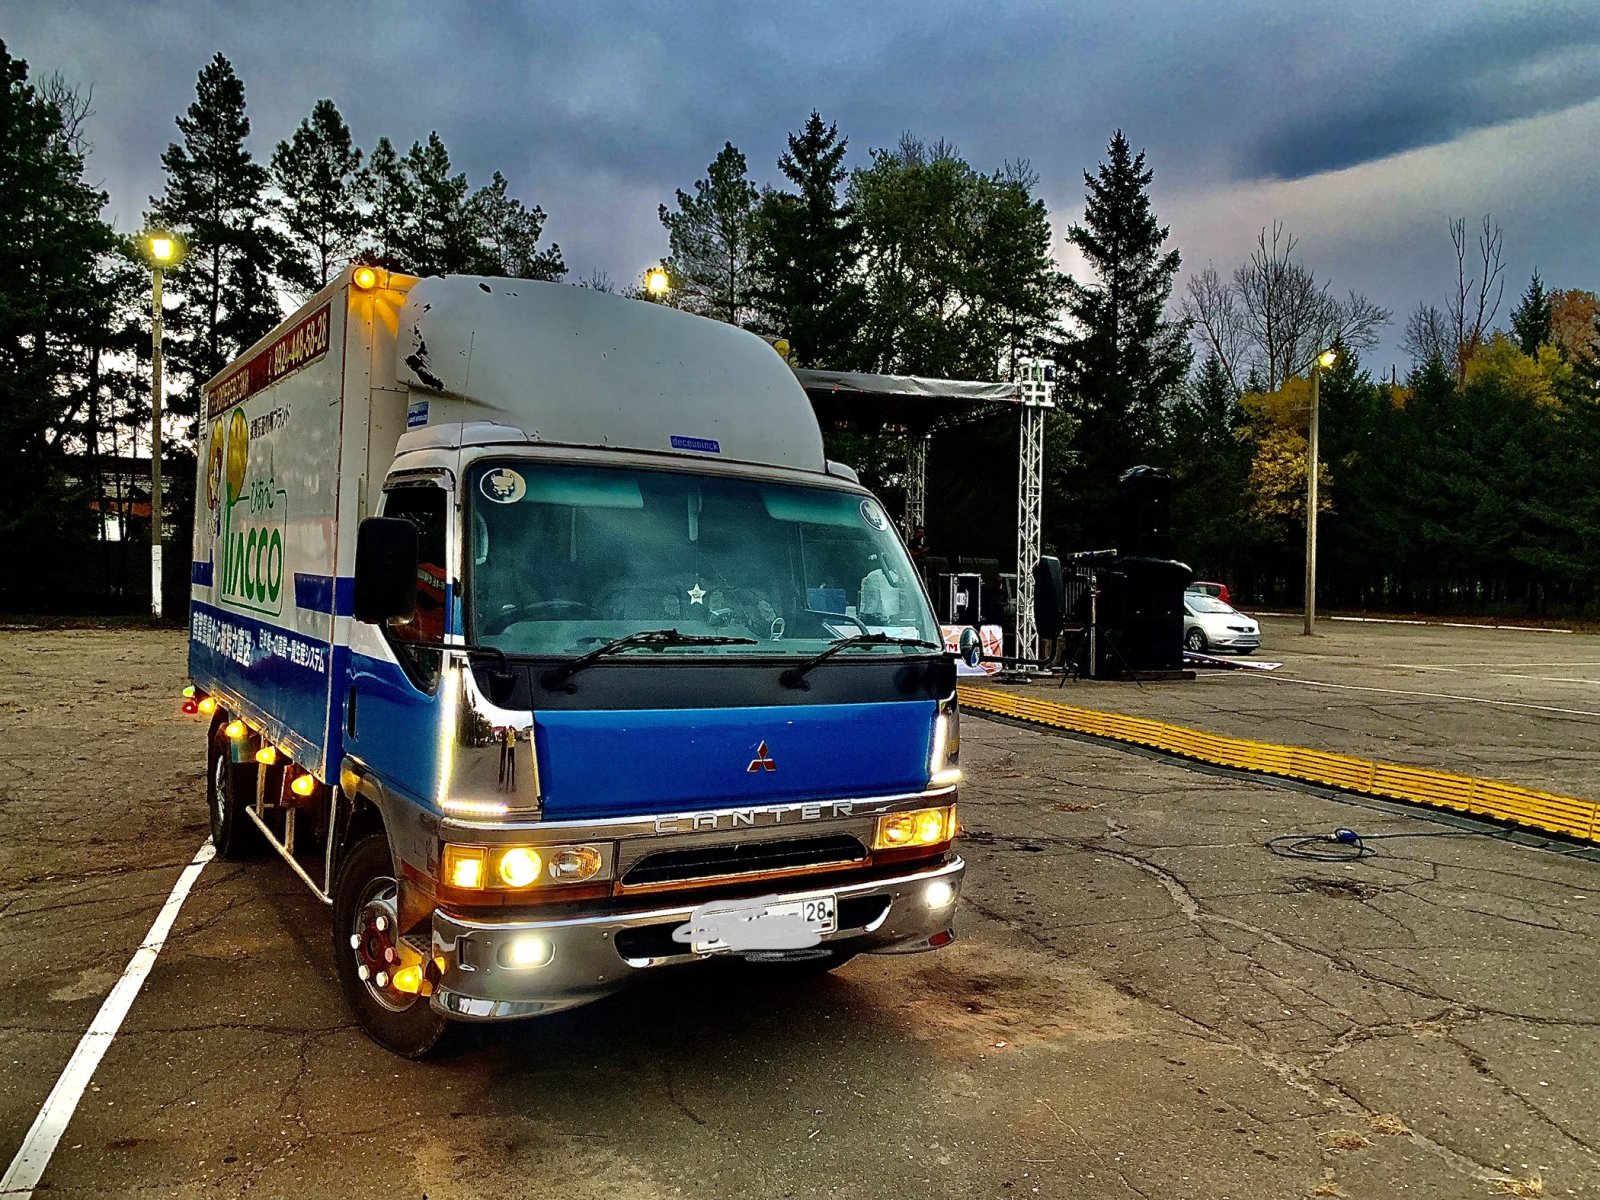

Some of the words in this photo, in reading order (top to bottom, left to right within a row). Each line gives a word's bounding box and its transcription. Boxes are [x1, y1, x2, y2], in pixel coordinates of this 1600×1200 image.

[672, 437, 719, 451] deceuninck
[654, 802, 853, 834] CANTER
[806, 901, 826, 921] 28
